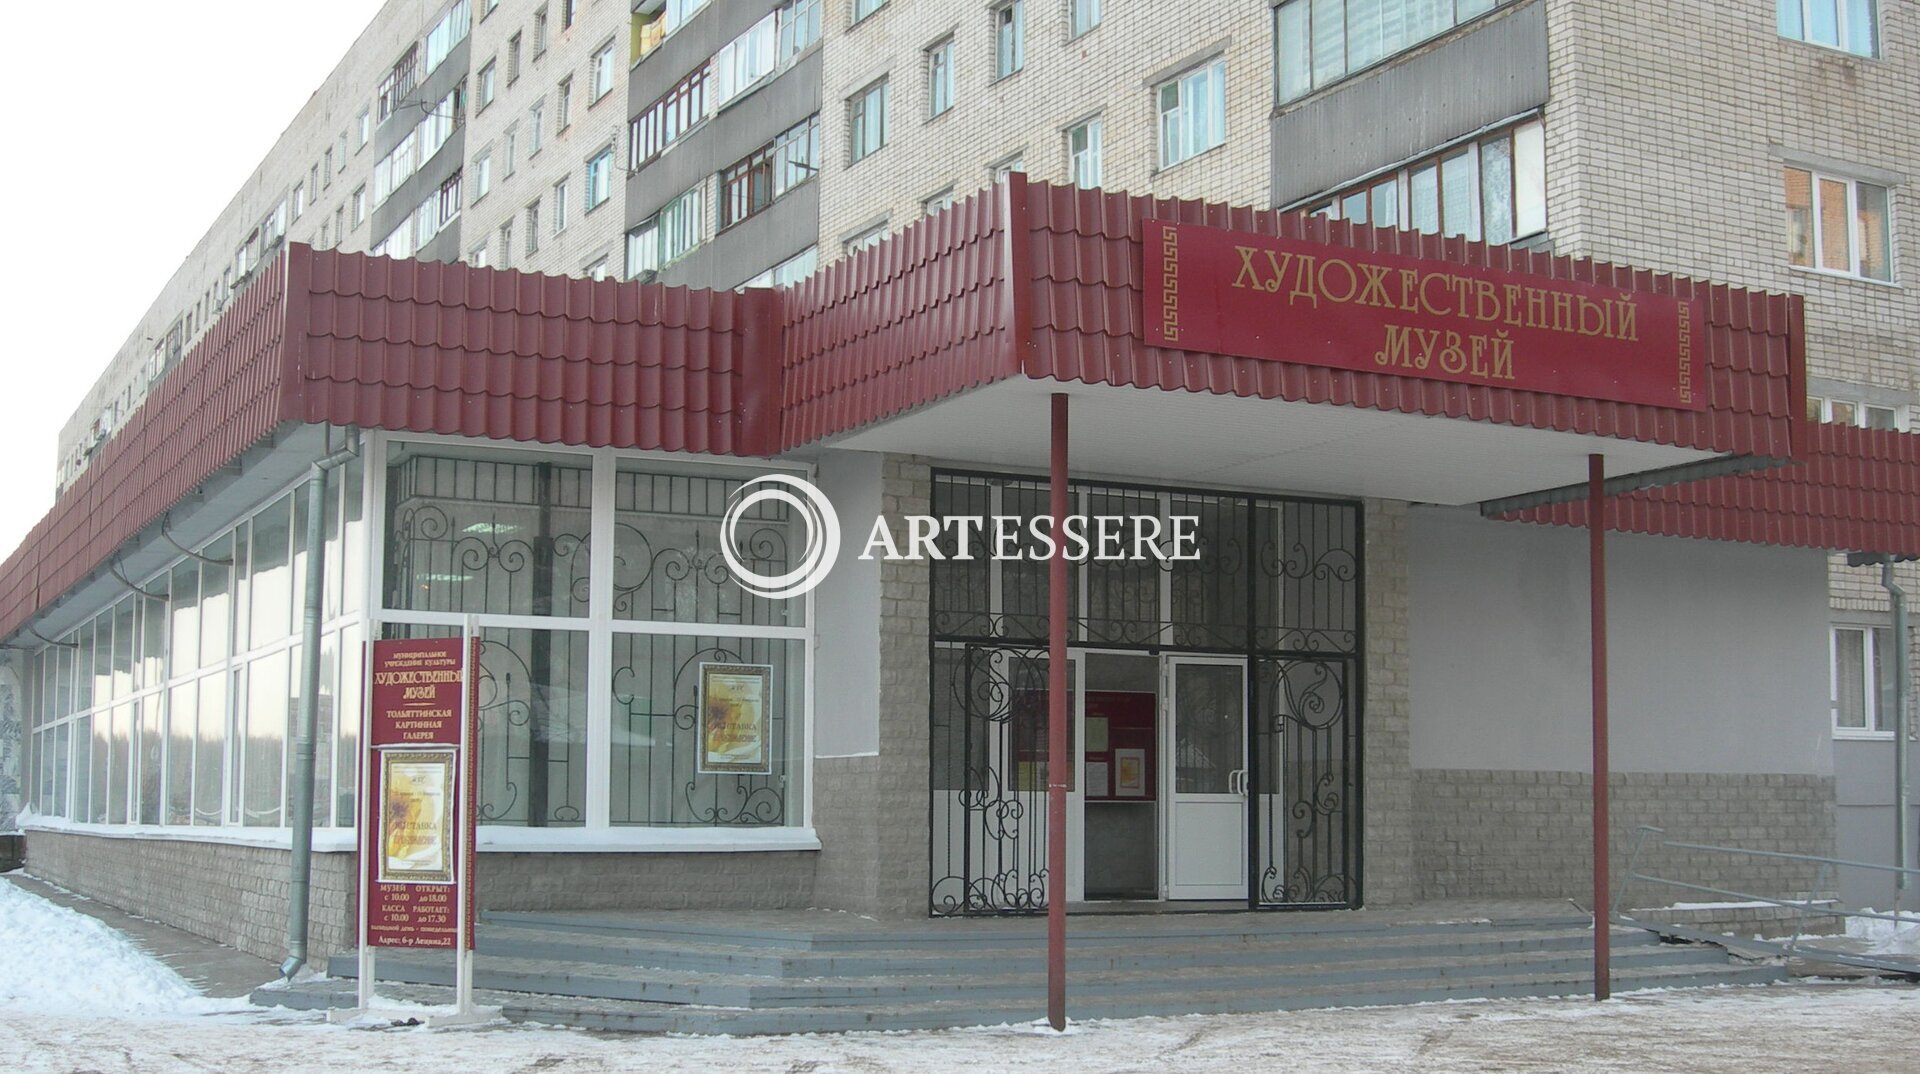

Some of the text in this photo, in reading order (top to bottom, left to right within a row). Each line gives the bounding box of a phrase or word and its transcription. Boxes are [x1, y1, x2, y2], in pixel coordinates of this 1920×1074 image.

[1232, 245, 1639, 342] ХУДОЖЕСТВЕННЫЙ
[1374, 324, 1516, 381] МУЗЕЙ
[424, 658, 456, 667] КУЛЬТУРЫ
[375, 670, 463, 686] ХУДОЖЕСТВЕННЫ
[403, 684, 436, 699] МУЗЕЙ
[386, 709, 452, 718] ТОЛЬЯТТИНСКАЯ
[395, 720, 442, 729] КАРТИННАЯ
[403, 731, 434, 740] ГАЛЕРЕЯ
[380, 884, 450, 893] МУЗЕЙ ОТКРЫТ:
[391, 893, 410, 901] 10.00
[429, 894, 447, 902] 18.00
[413, 905, 450, 914] РАБОТАЕТ:
[391, 913, 409, 921] 10.00
[417, 915, 427, 923] до
[428, 915, 446, 923] 17.30
